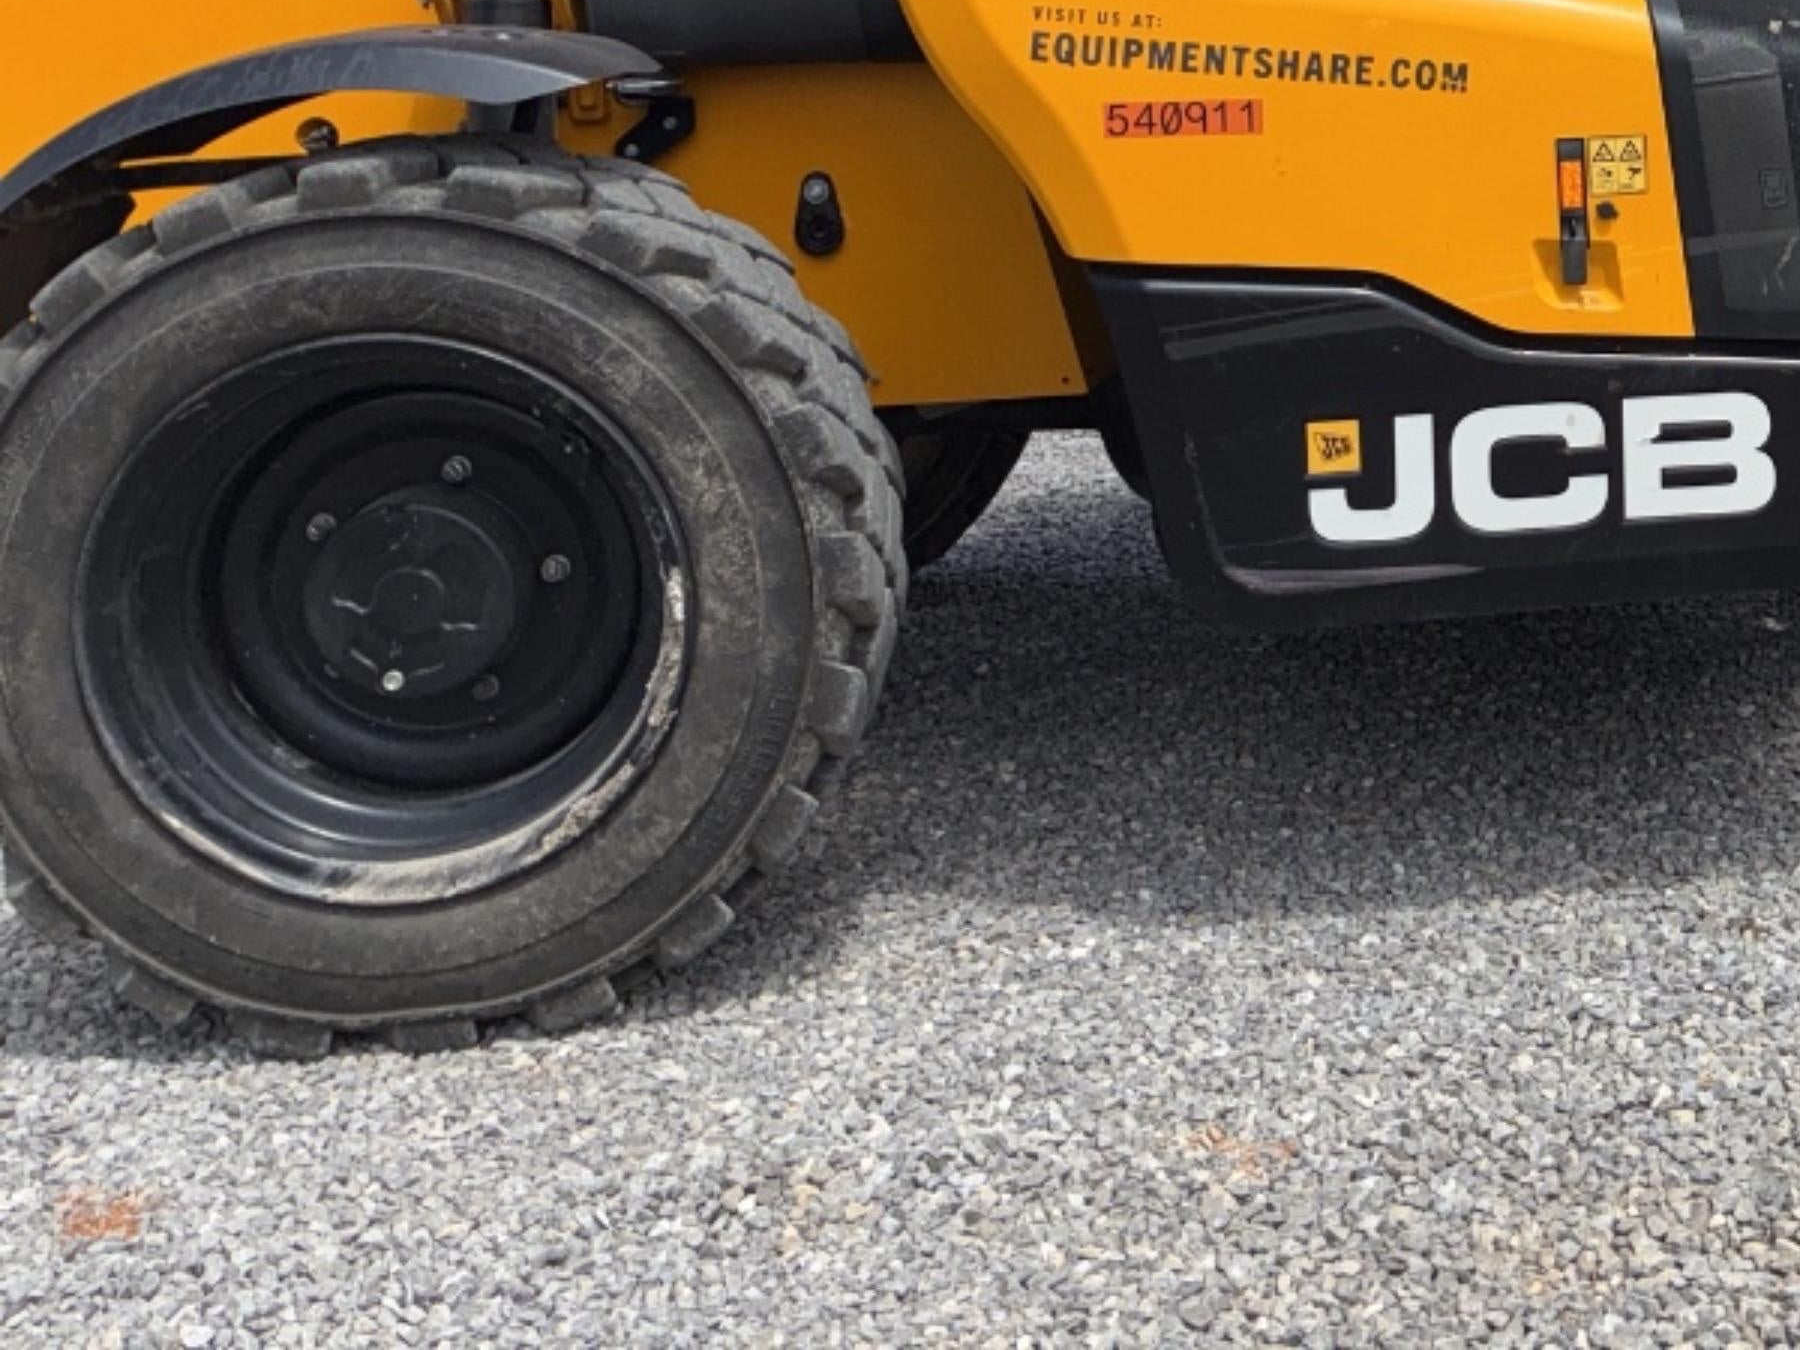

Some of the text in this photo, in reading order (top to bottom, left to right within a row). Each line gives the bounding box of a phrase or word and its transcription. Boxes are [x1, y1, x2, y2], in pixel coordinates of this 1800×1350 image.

[1032, 5, 1163, 29] VISIT US AT:
[1030, 30, 1468, 93] EQUIPMENTSHARE.COM
[1106, 98, 1256, 138] 540911
[1306, 391, 1777, 543] JCB
